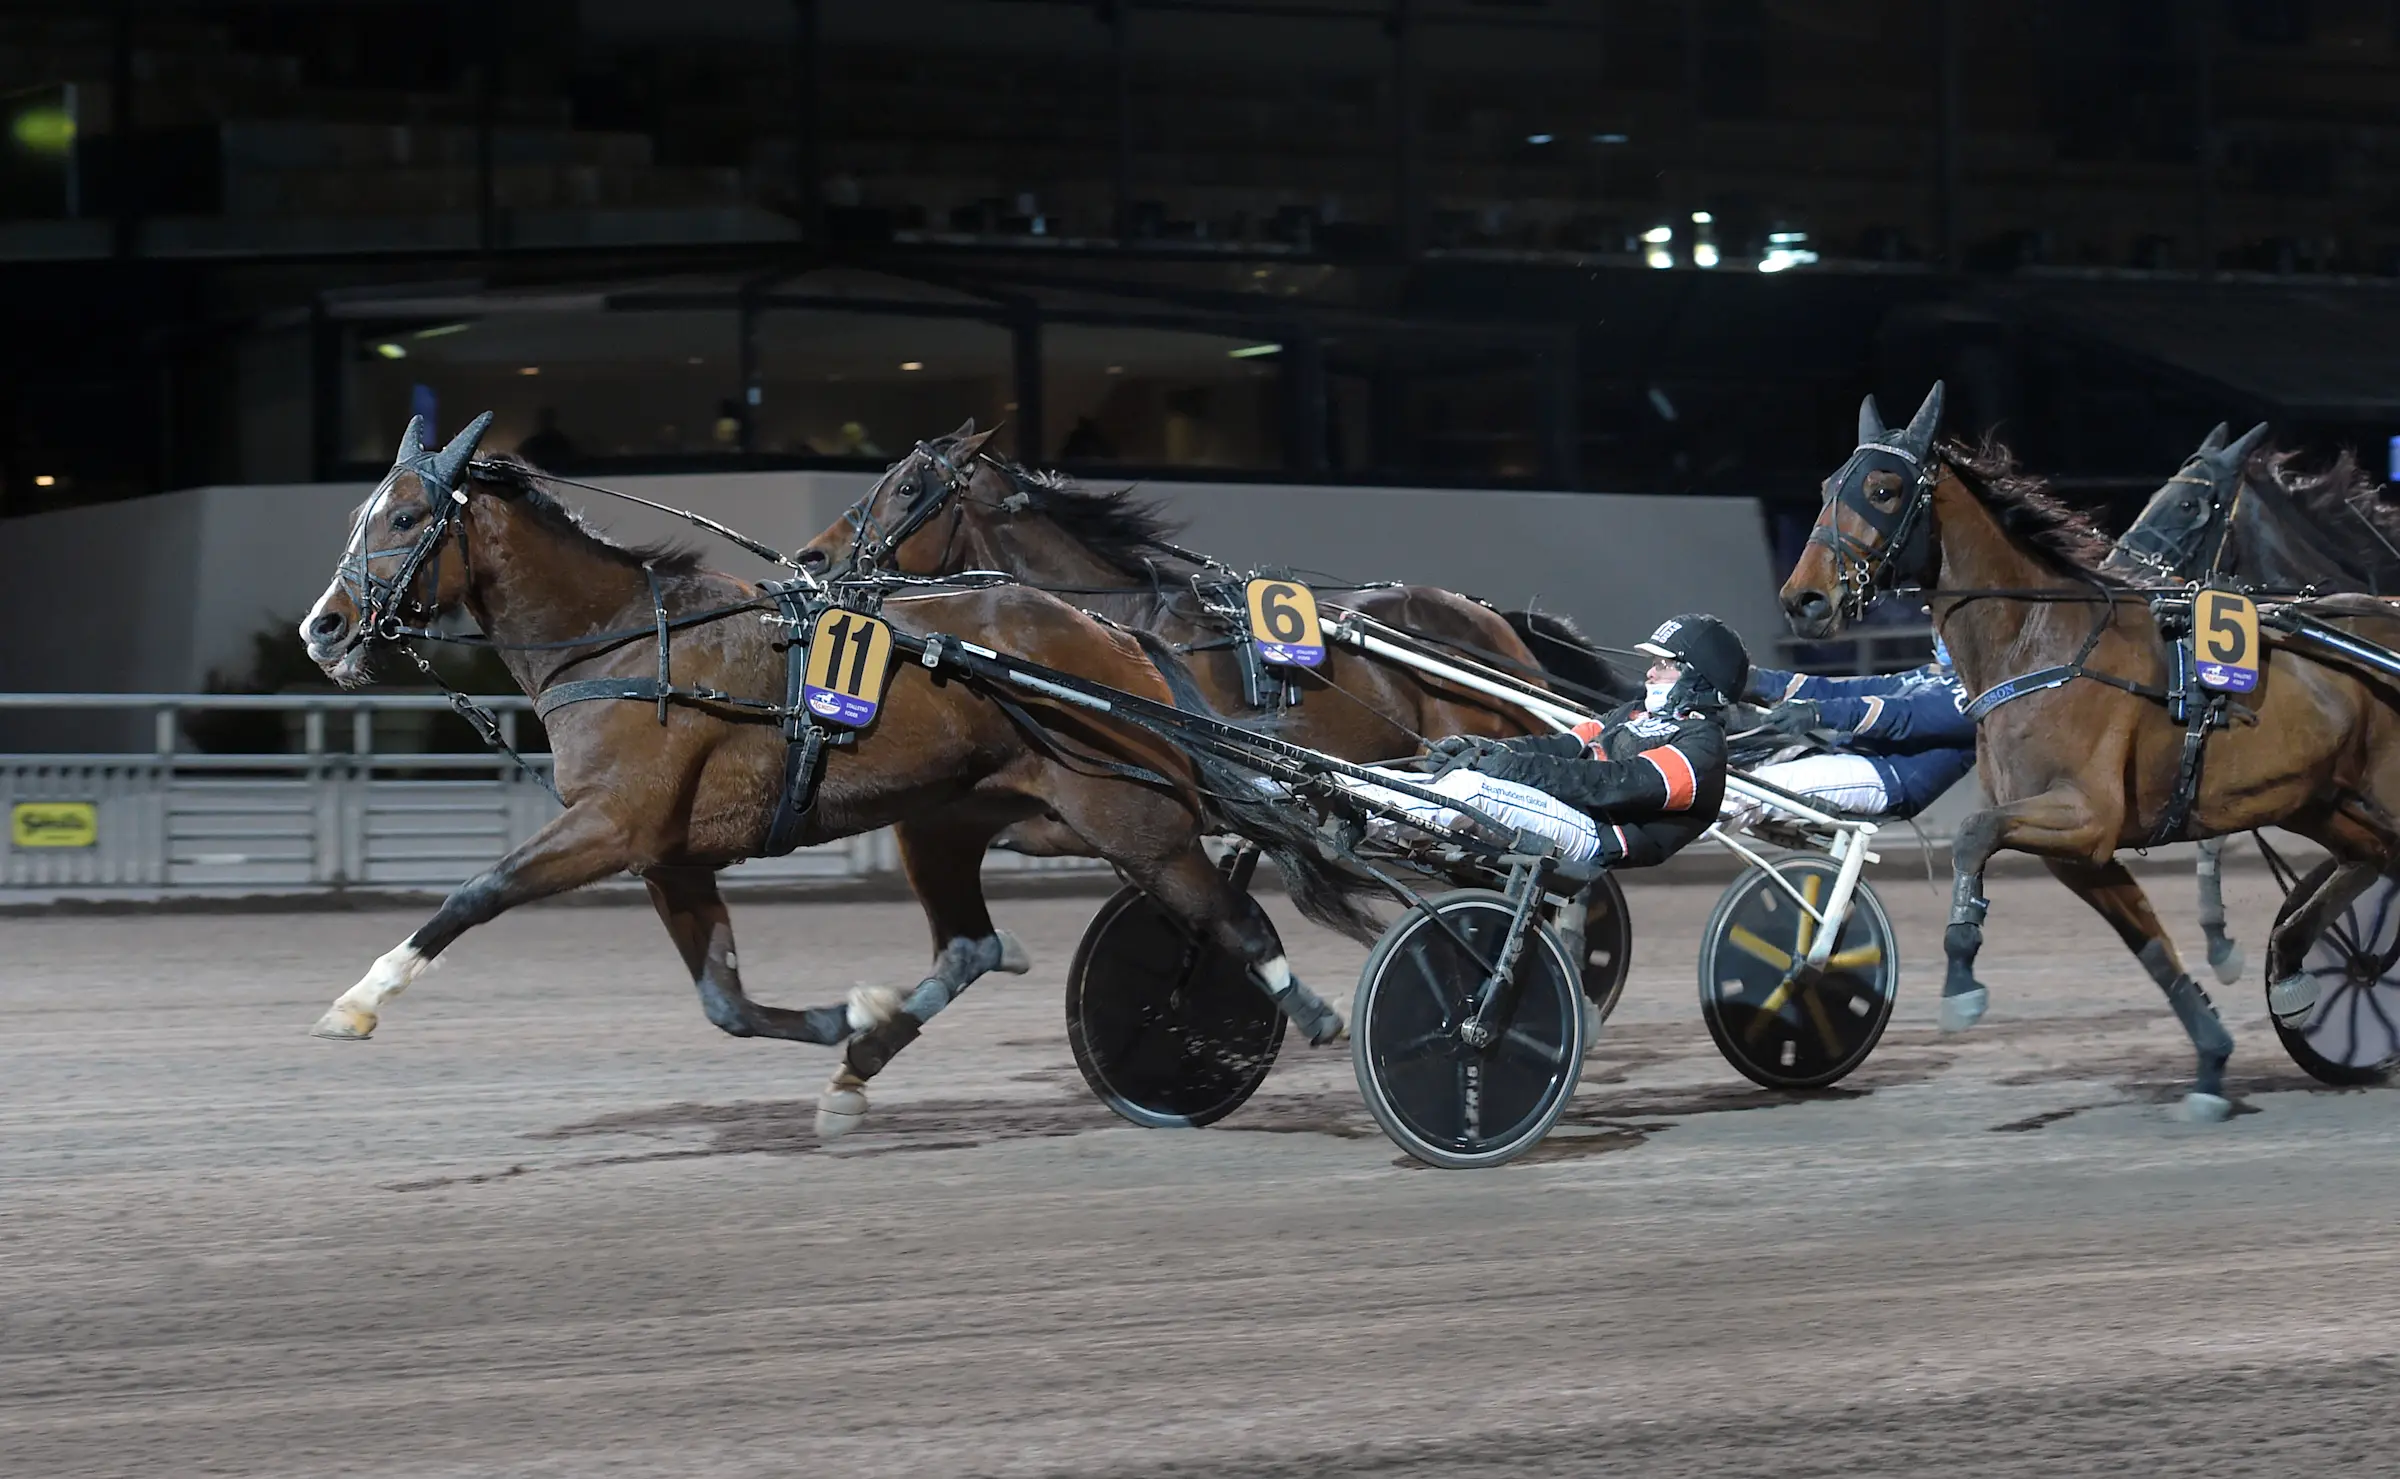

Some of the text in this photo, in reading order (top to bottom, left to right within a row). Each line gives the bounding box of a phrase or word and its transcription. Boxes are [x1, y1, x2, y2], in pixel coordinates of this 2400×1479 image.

[1261, 584, 1305, 643] 6
[2208, 594, 2246, 664] 5
[825, 614, 875, 696] 11
